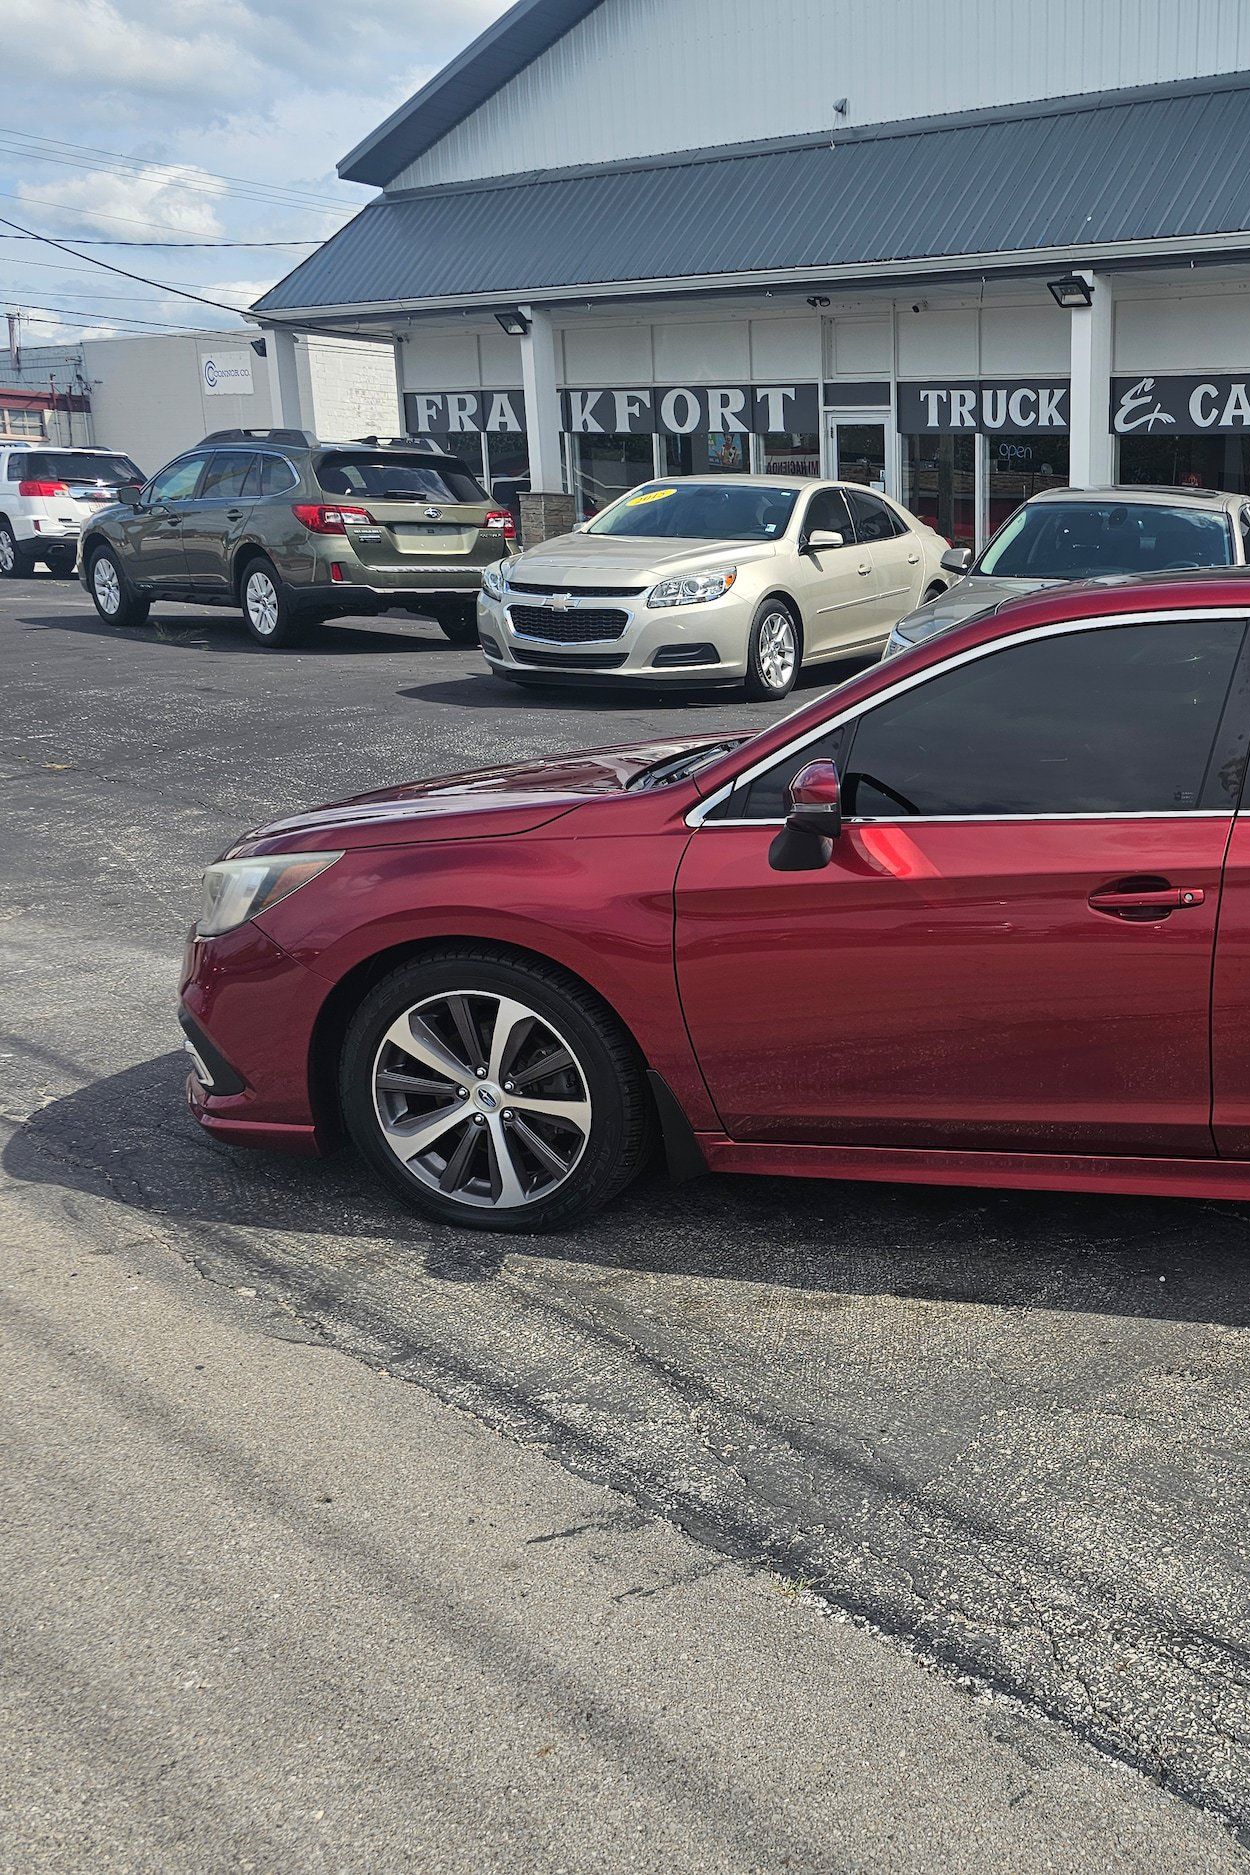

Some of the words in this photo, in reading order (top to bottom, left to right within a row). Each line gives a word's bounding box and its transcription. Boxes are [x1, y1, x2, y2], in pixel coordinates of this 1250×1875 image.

[415, 388, 796, 434] FRAKFORT
[920, 388, 1067, 428] TRUCK
[1113, 378, 1176, 433] &
[999, 443, 1032, 459] open
